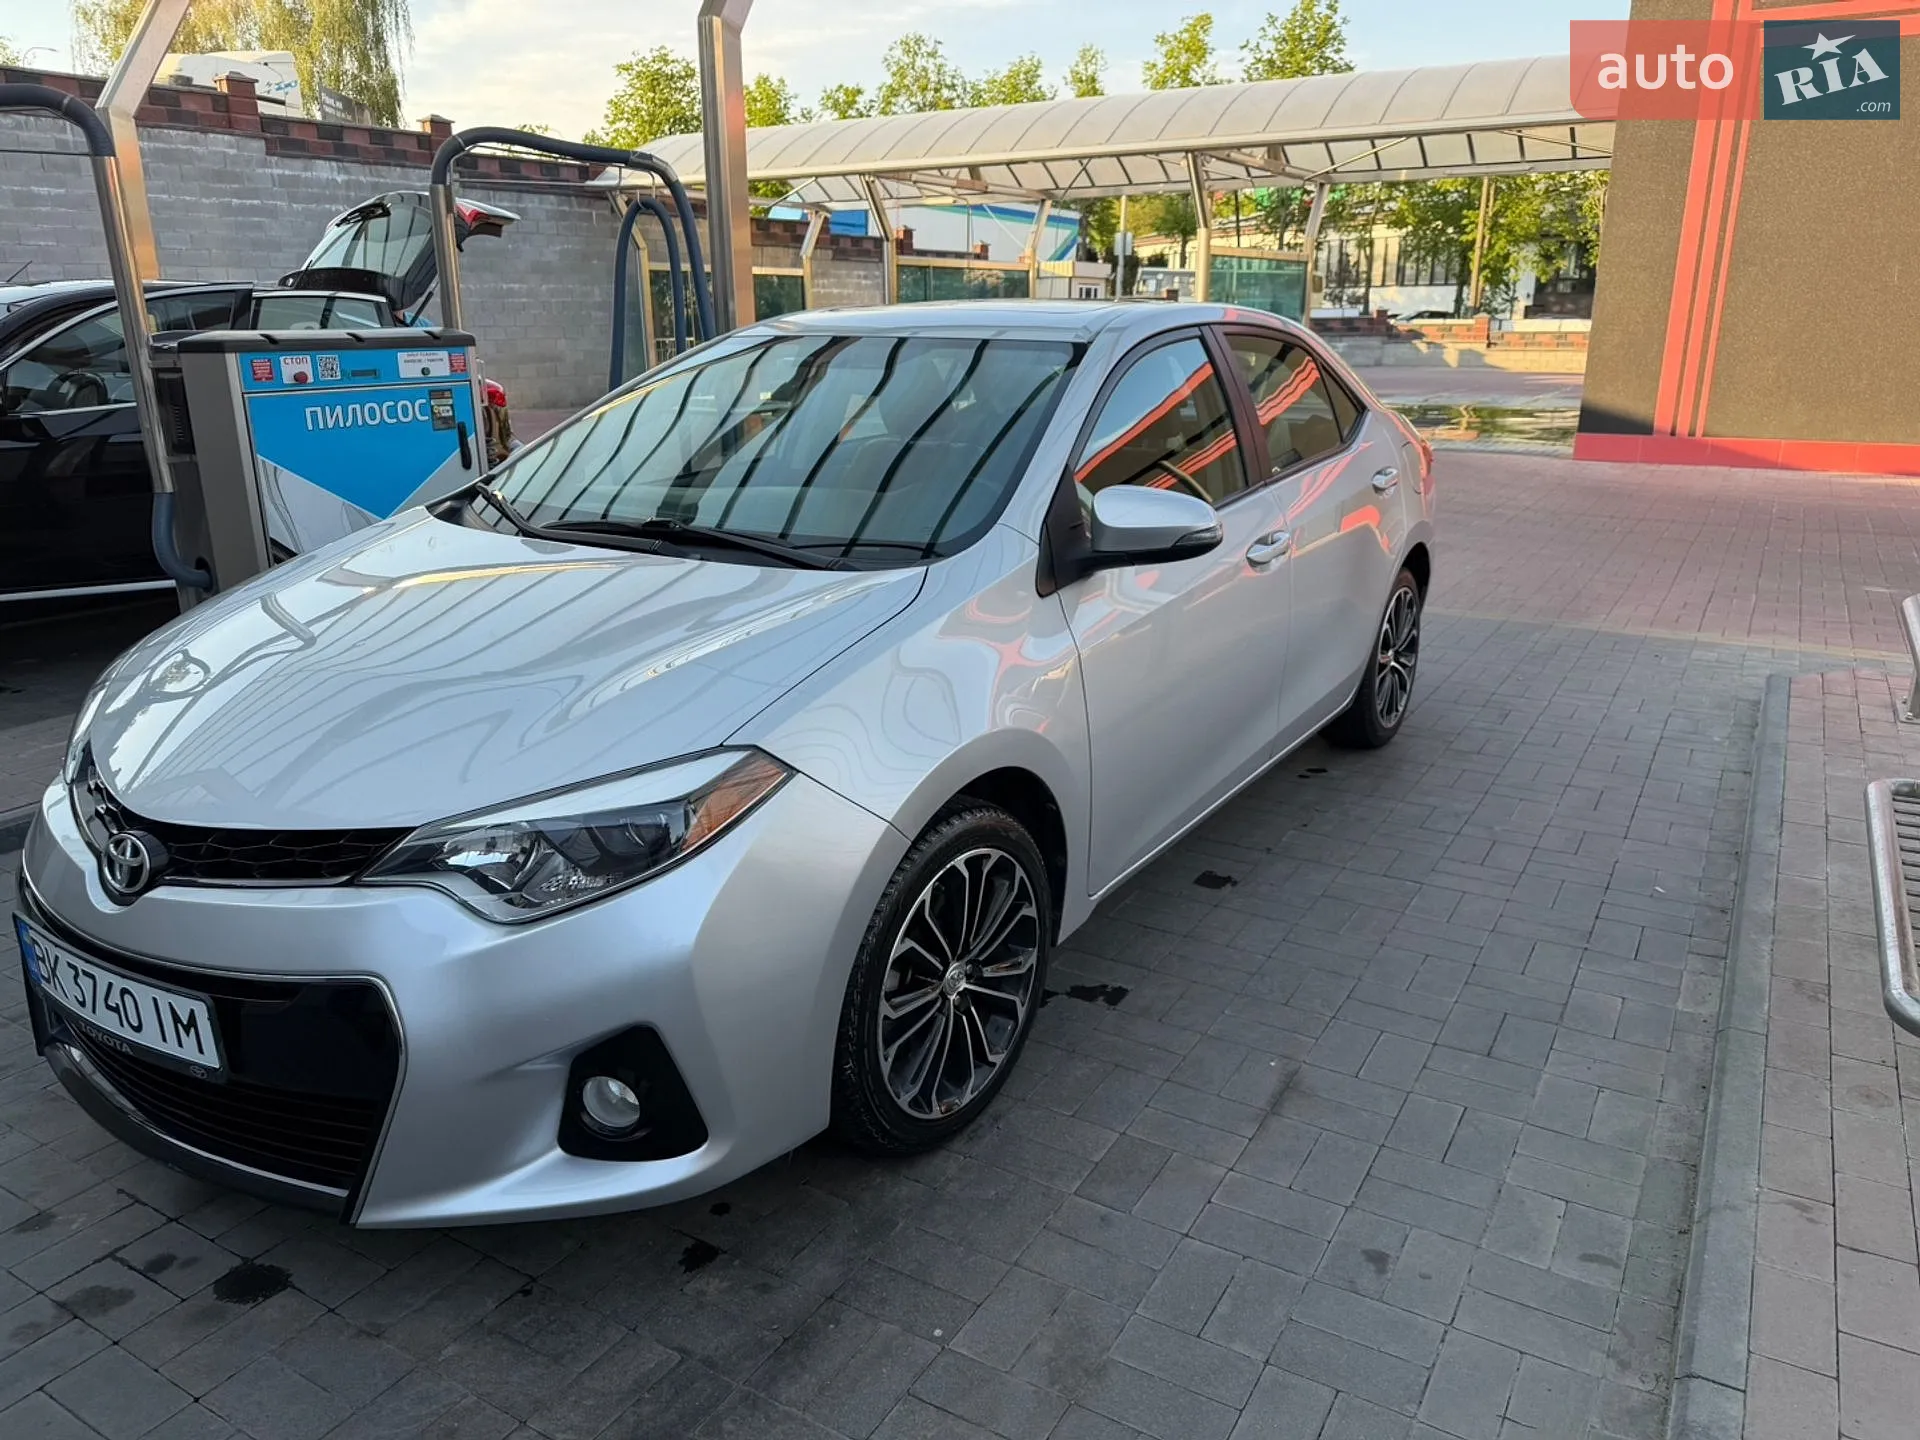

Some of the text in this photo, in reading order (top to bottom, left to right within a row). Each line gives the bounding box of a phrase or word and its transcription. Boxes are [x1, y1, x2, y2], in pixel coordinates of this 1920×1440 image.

[283, 356, 308, 365] СТОП
[304, 398, 430, 431] ПИЛОСОС
[31, 937, 205, 1056] BK 3740 IM
[79, 1020, 134, 1055] TOYOTA
